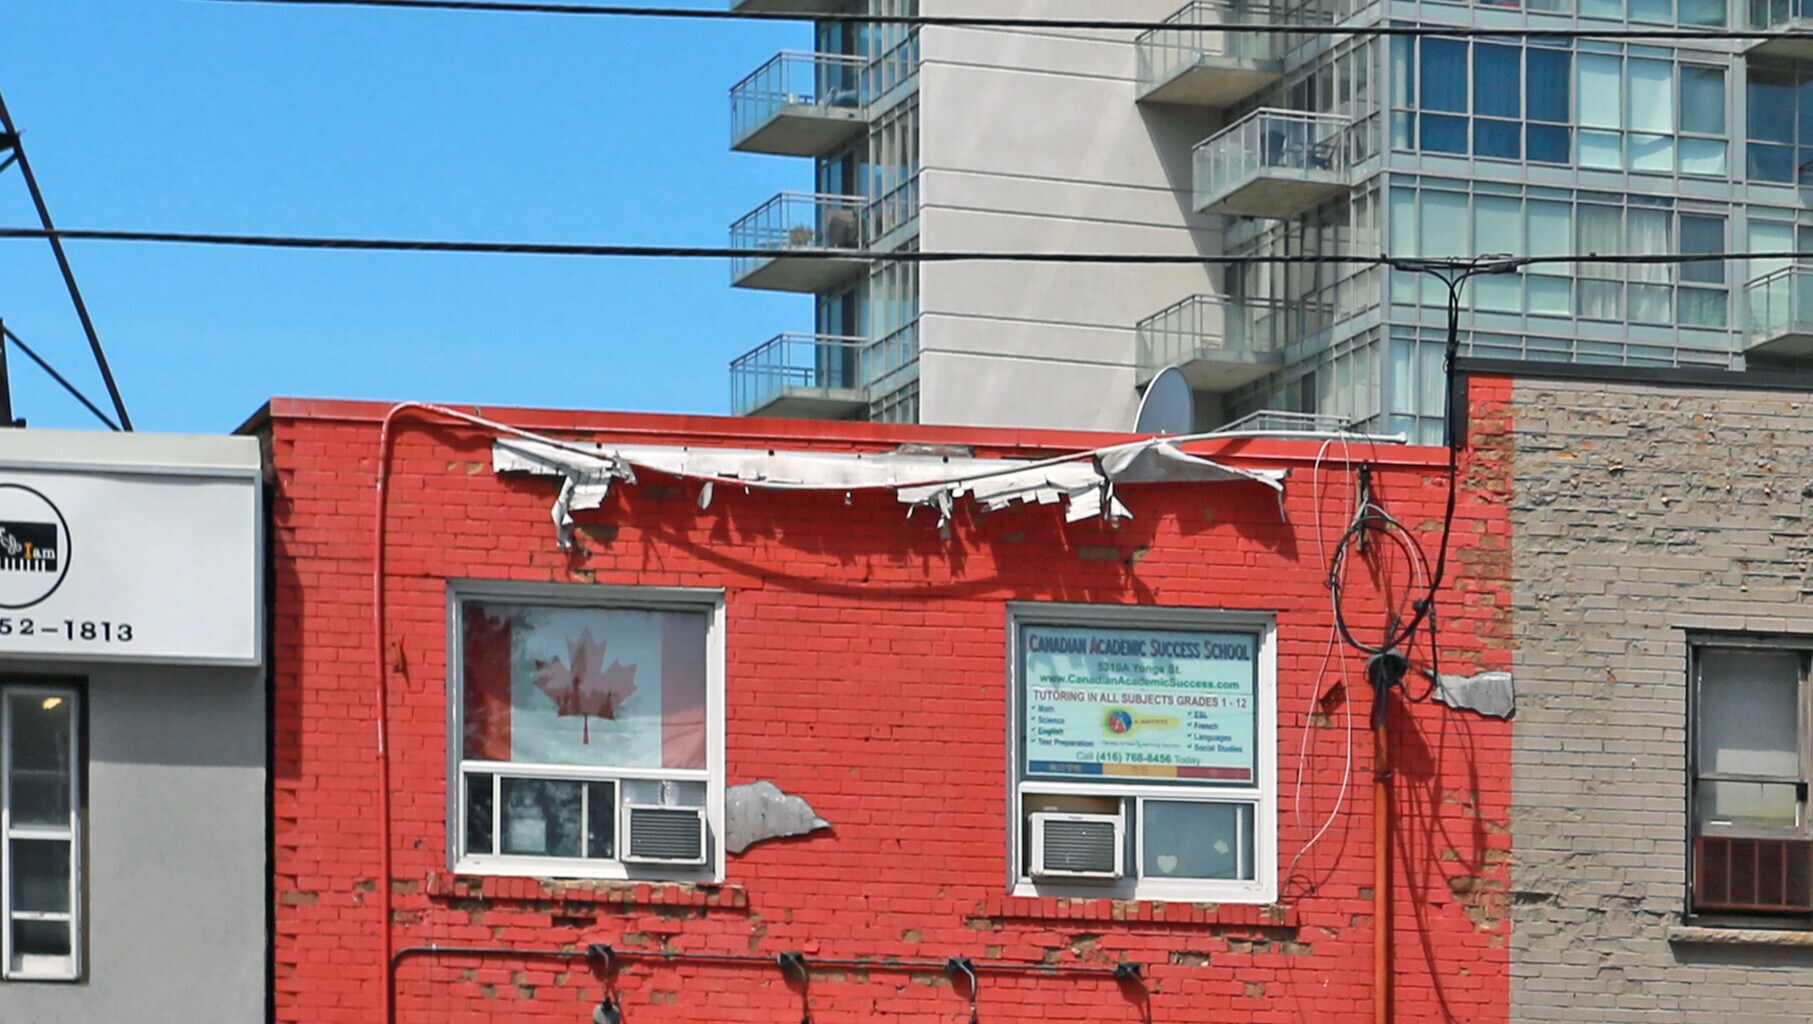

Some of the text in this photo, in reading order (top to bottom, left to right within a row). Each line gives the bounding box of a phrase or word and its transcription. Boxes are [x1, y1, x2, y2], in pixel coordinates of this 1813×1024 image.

[1150, 638, 1200, 658] SUCCESS
[1204, 640, 1250, 660] SCHOOL
[1133, 662, 1164, 675] Yonge
[1040, 673, 1240, 689] www.CanadianAcademicSuccess.com
[1034, 689, 1085, 702] TUTORING
[1087, 692, 1098, 702] IN
[1100, 692, 1119, 704] ALL
[1121, 693, 1174, 706] SUBJECTS
[1176, 696, 1219, 708] GRADES
[1236, 698, 1247, 709] 12
[1038, 705, 1055, 713] Math
[1038, 715, 1065, 724] Science
[1194, 722, 1218, 730] French
[1038, 727, 1064, 736] English
[1194, 733, 1232, 742] Languages
[1054, 739, 1094, 748] Preparation
[1194, 744, 1243, 753] Social Studies
[1096, 752, 1122, 763] (416)
[1174, 755, 1200, 766] Today
